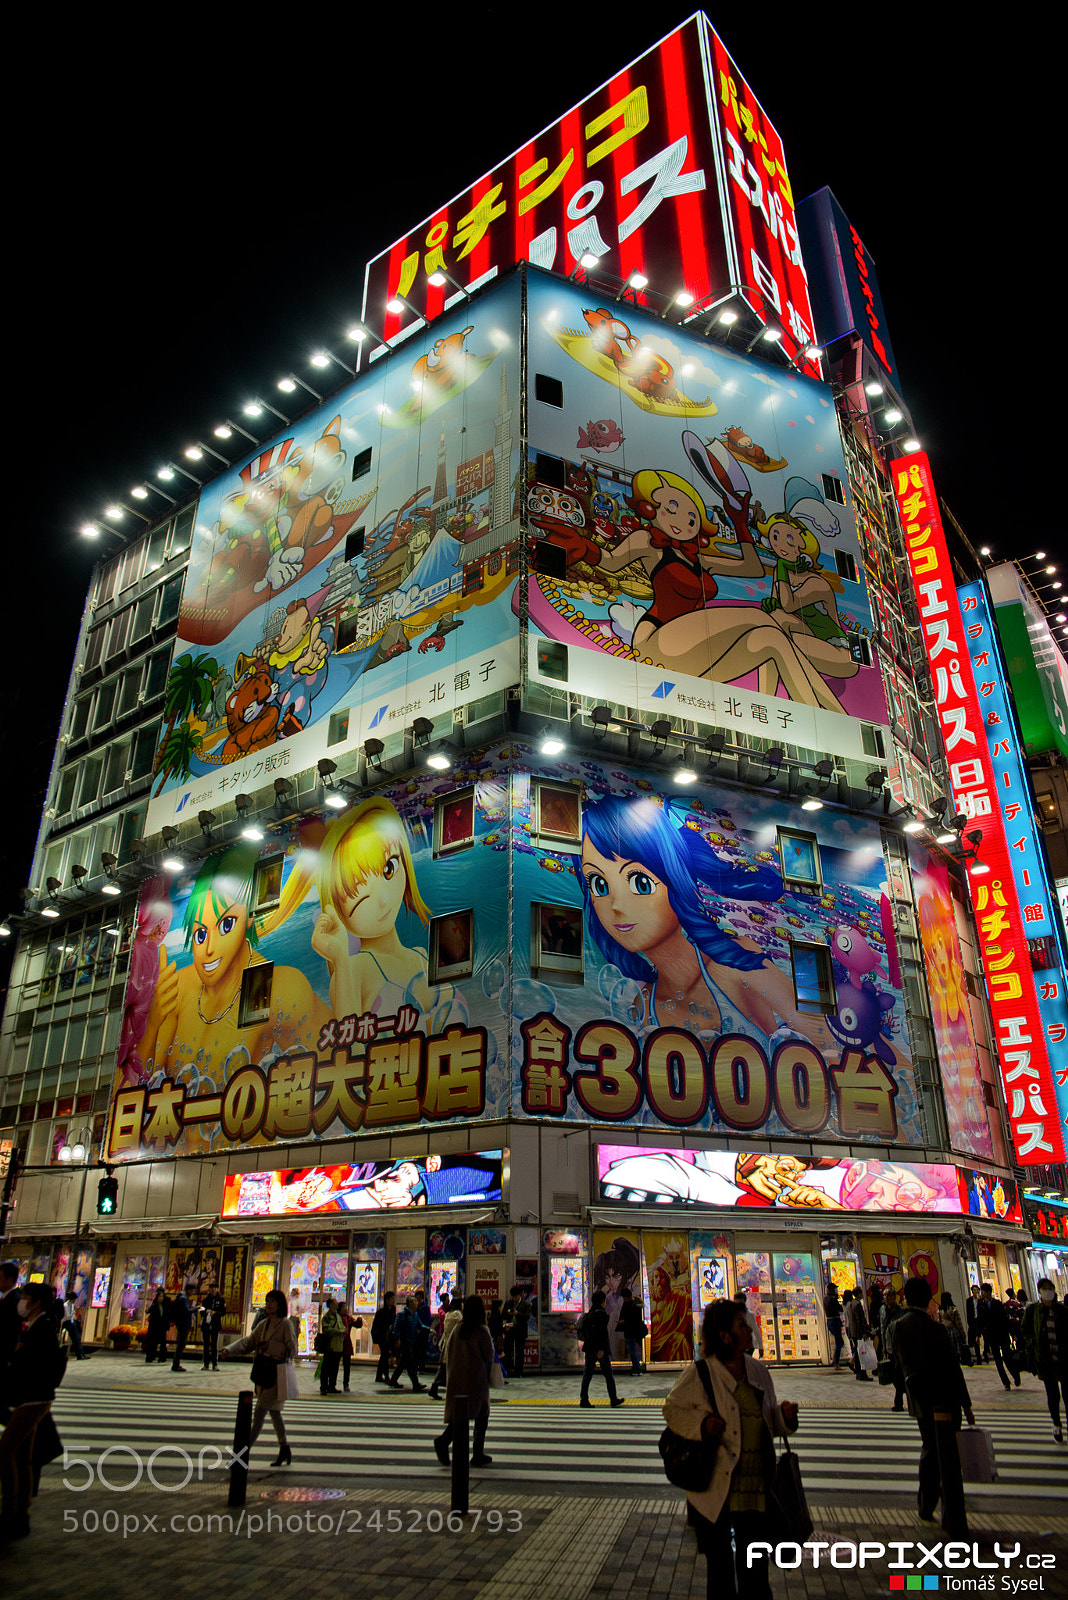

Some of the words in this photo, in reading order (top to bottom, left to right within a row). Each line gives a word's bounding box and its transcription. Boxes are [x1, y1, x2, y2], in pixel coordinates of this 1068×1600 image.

[394, 85, 650, 300] パチンコ
[719, 69, 795, 211] パチンコ
[726, 127, 808, 287] エスパス
[849, 224, 892, 373] カラオケ
[897, 464, 939, 575] パチンコ
[919, 578, 977, 752] エスパス
[388, 698, 423, 721] 株式会社
[428, 658, 497, 705] 北電子
[676, 691, 717, 712] 株式会社
[724, 696, 795, 729] 北電子
[218, 747, 293, 792] キタック販売
[962, 596, 1046, 923] カラオケ&パーティー館
[976, 879, 1023, 1001] パチンコ
[109, 1024, 486, 1157] 日本一の超大型店
[319, 1006, 418, 1050] メガホール
[520, 1012, 572, 1115] 合計
[574, 1020, 898, 1138] 3000台
[999, 1015, 1054, 1156] エスパス
[475, 1269, 499, 1279] スロット
[477, 1286, 498, 1296] エスパス
